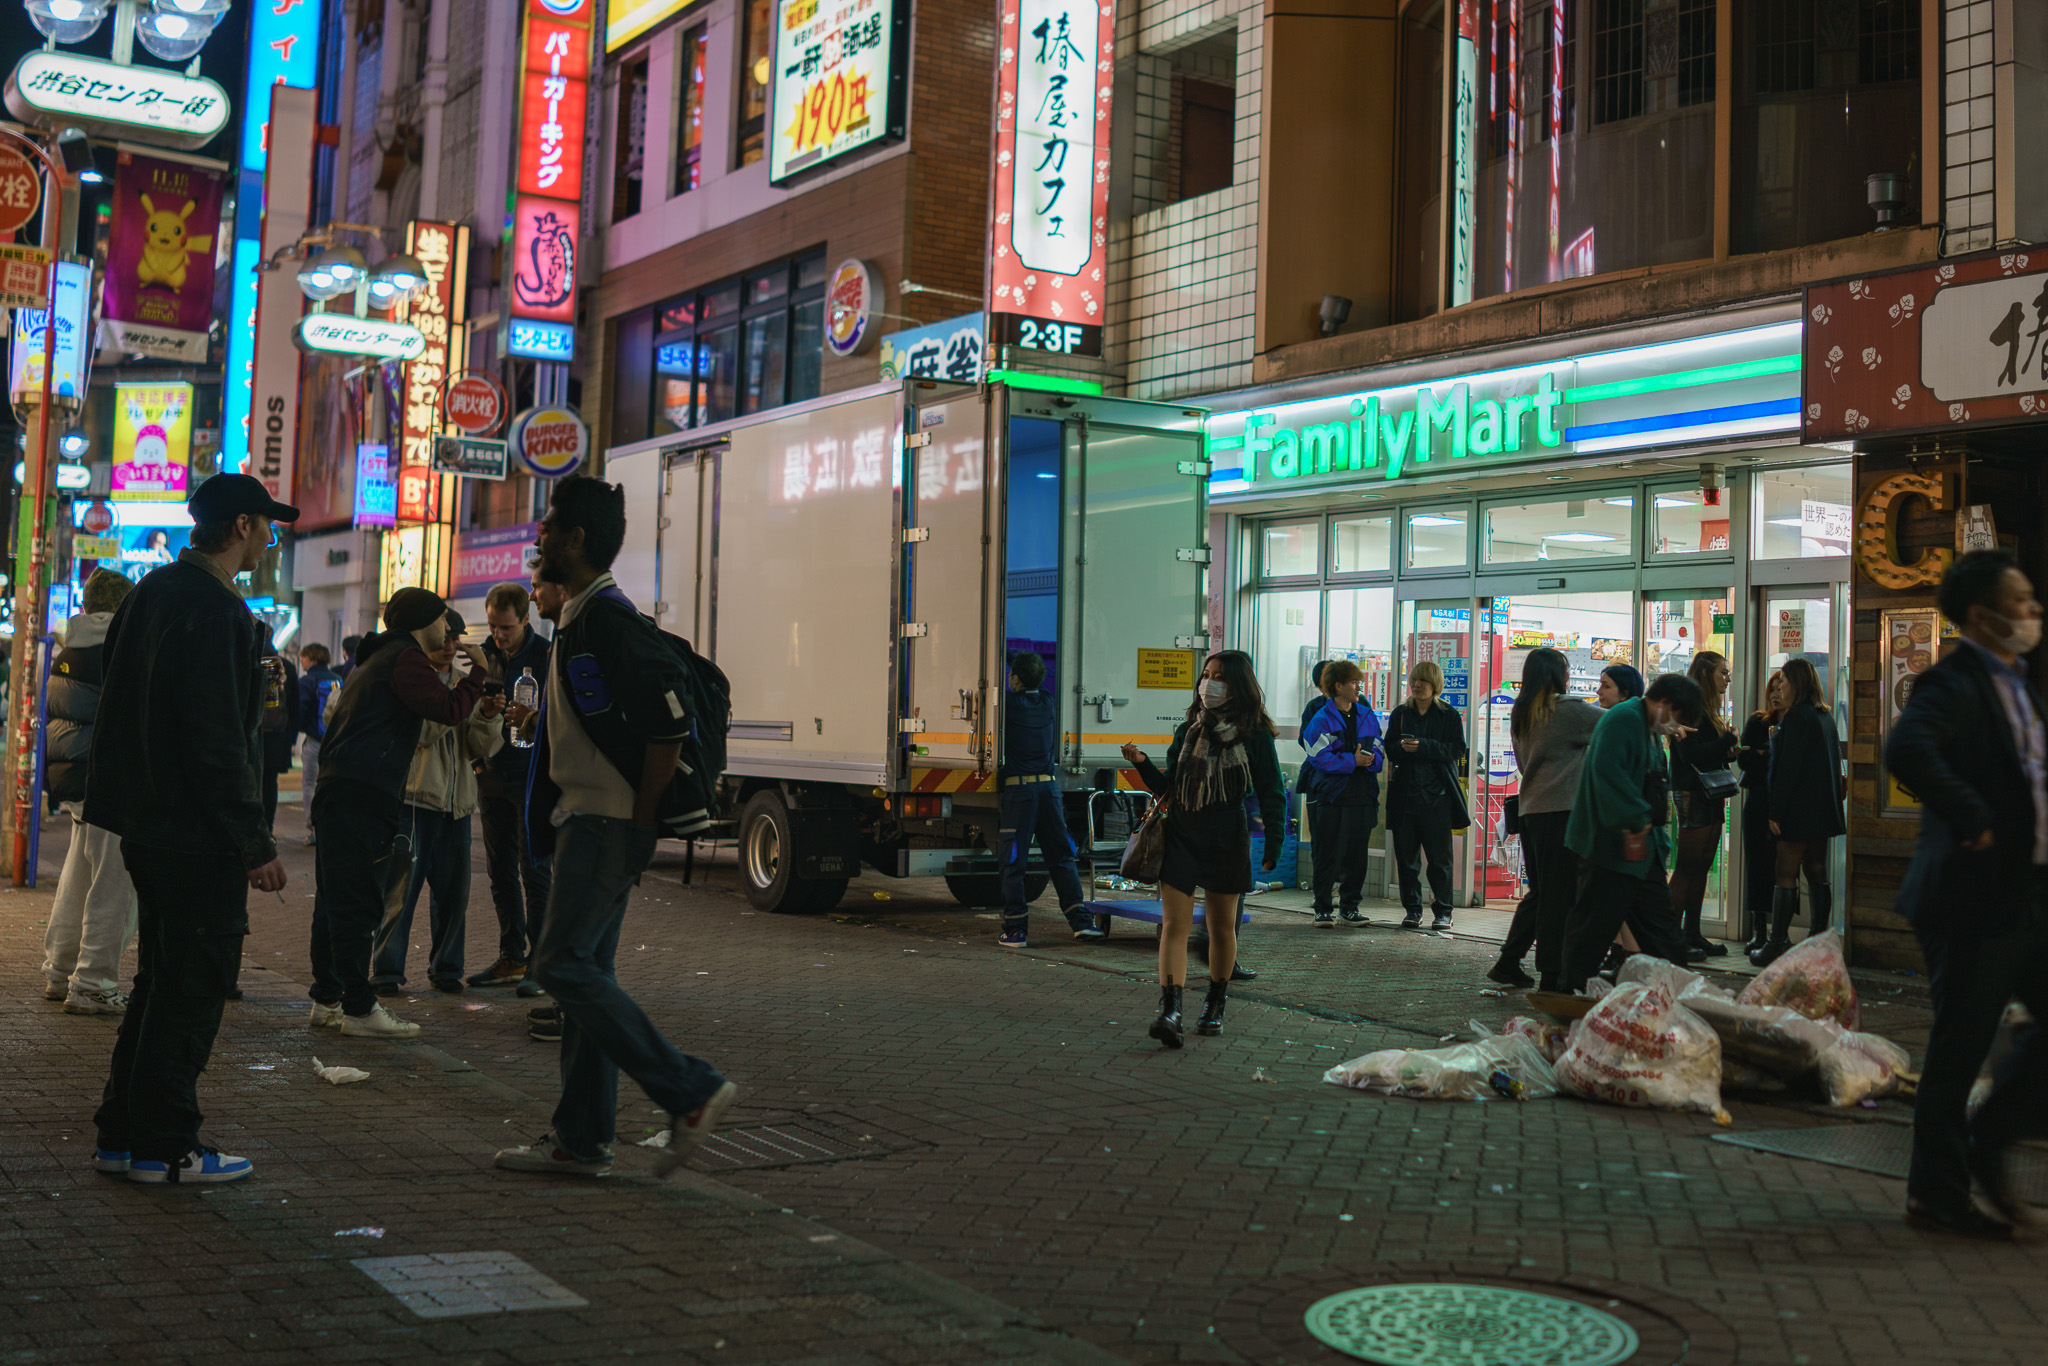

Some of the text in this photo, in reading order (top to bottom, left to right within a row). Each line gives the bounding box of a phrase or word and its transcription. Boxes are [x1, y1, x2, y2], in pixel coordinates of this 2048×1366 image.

[28, 70, 217, 117] 渋谷センター街
[537, 31, 571, 189] バーガーキング
[797, 71, 866, 152] 190円
[1032, 12, 1086, 238] 椿屋カフェ
[309, 324, 420, 350] 渋谷センター街
[511, 326, 571, 352] センタービル
[909, 331, 982, 382] 麻雀
[451, 392, 494, 417] 消火栓
[525, 423, 578, 441] BURGER
[1243, 372, 1562, 481] FamilyMart
[259, 395, 286, 499] atmos
[525, 436, 579, 459] KING
[1825, 522, 1850, 538] 認めた
[1418, 641, 1452, 665] 銀行
[1443, 677, 1465, 687] たばこ
